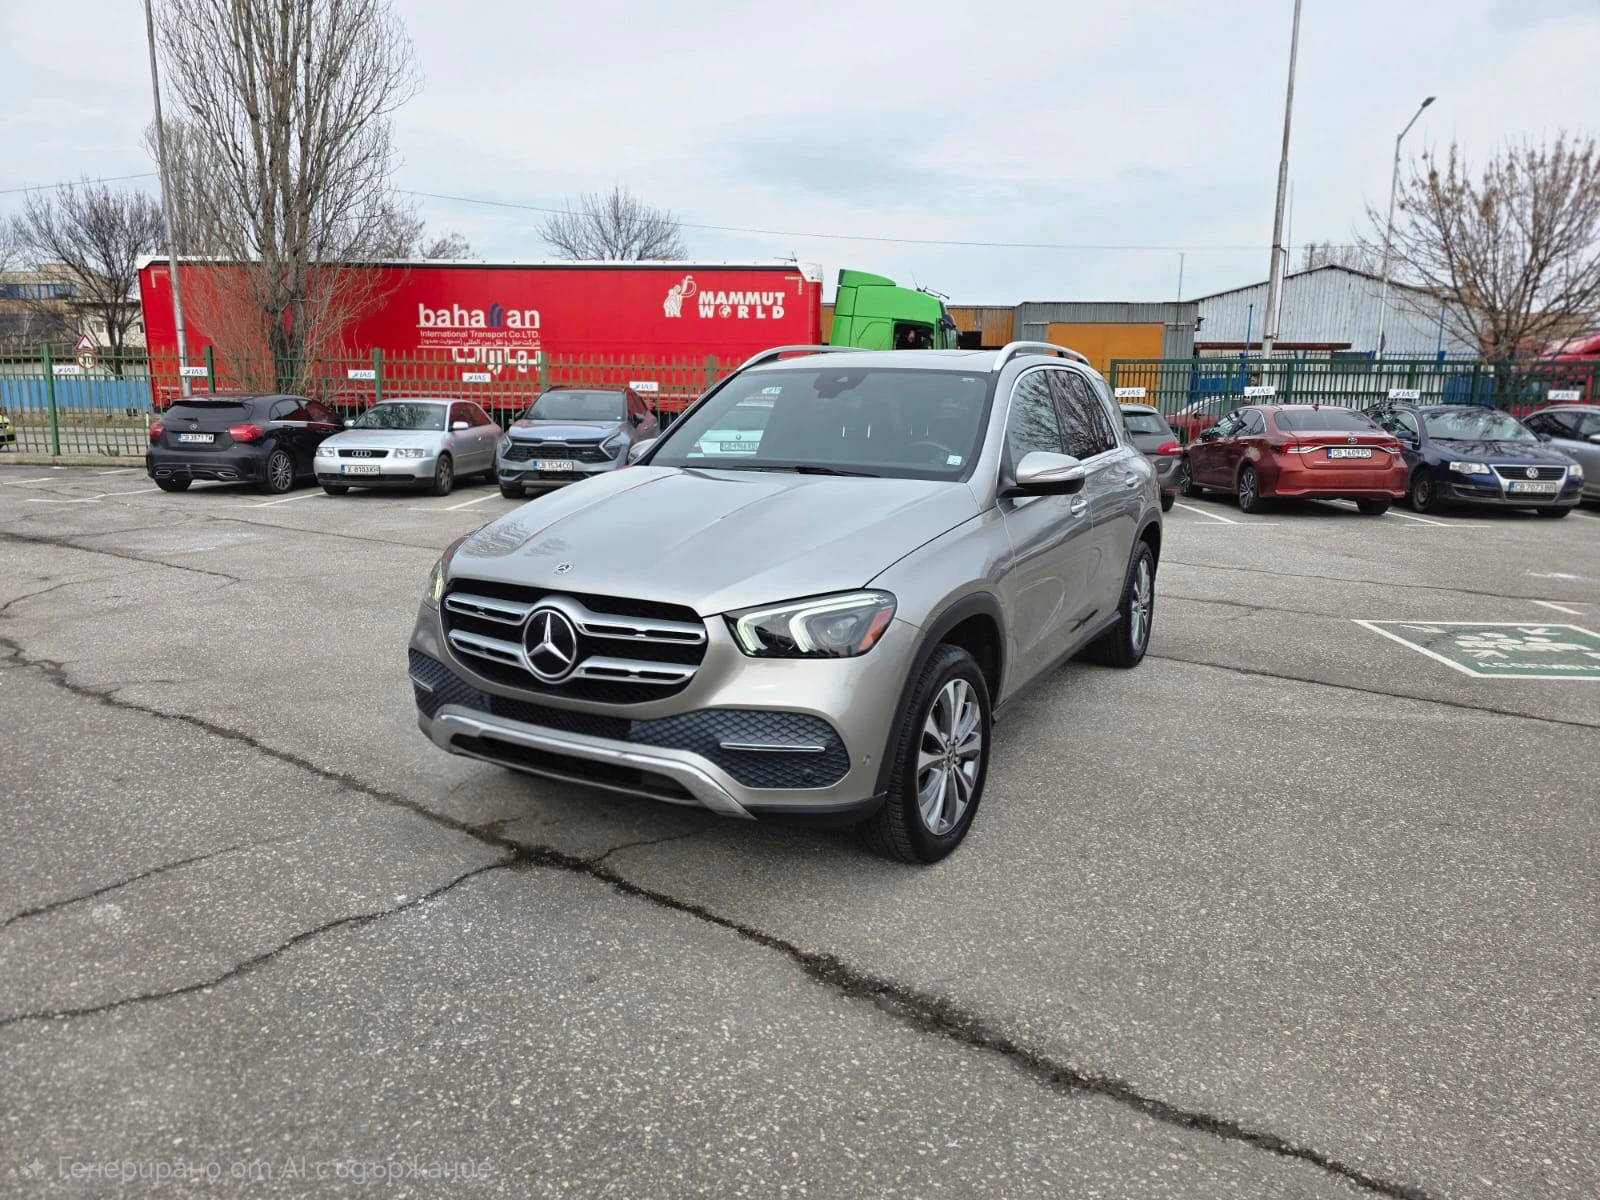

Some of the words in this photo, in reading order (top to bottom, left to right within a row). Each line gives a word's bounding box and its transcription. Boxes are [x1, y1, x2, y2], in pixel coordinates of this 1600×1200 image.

[699, 291, 785, 306] MAMMUT
[699, 305, 785, 319] WORLD
[420, 330, 468, 338] International
[470, 330, 507, 339] Transport
